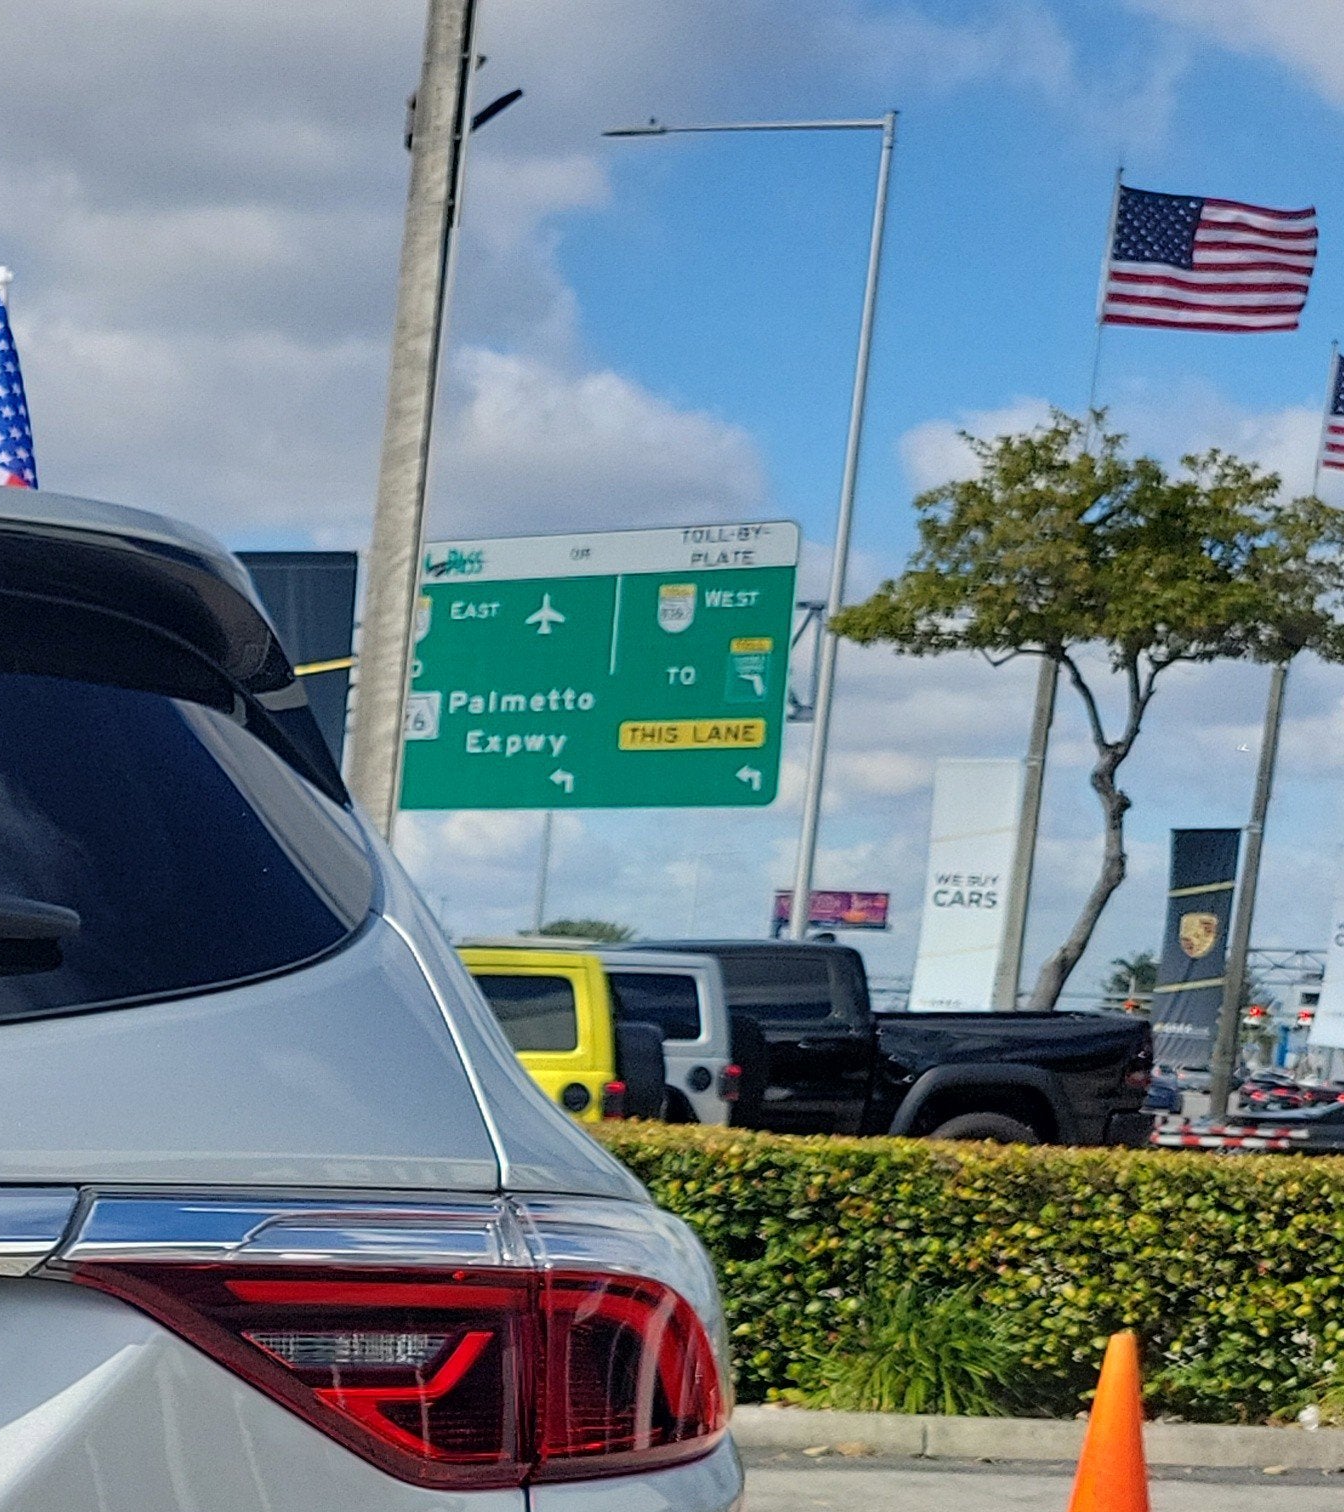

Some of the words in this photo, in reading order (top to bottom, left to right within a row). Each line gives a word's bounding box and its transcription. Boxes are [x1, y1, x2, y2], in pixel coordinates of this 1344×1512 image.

[690, 551, 755, 567] PLATE
[704, 589, 759, 608] WEST
[450, 601, 500, 620] EAST
[666, 666, 696, 685] TO
[449, 688, 596, 714] Palmetto
[628, 726, 678, 743] THIS
[693, 724, 755, 743] LANE
[465, 730, 567, 757] Expwy
[933, 888, 998, 909] CARS
